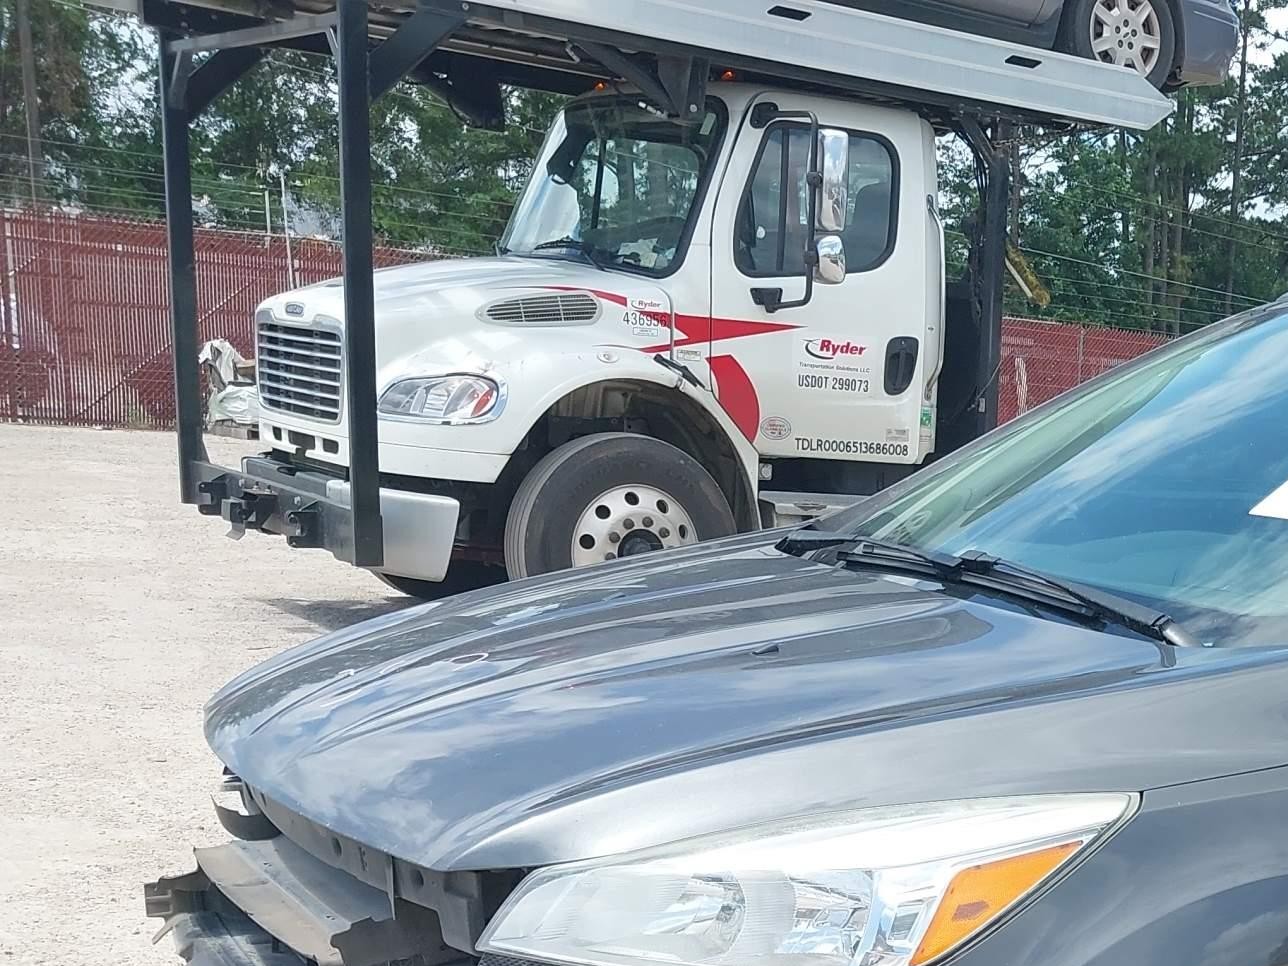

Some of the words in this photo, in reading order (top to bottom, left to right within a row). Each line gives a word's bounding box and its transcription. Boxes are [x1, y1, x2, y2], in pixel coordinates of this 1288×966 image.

[638, 300, 661, 308] Ryder
[623, 311, 667, 328] 436956
[819, 339, 867, 356] Ryder
[798, 374, 829, 389] USDOT
[832, 377, 869, 393] 299073
